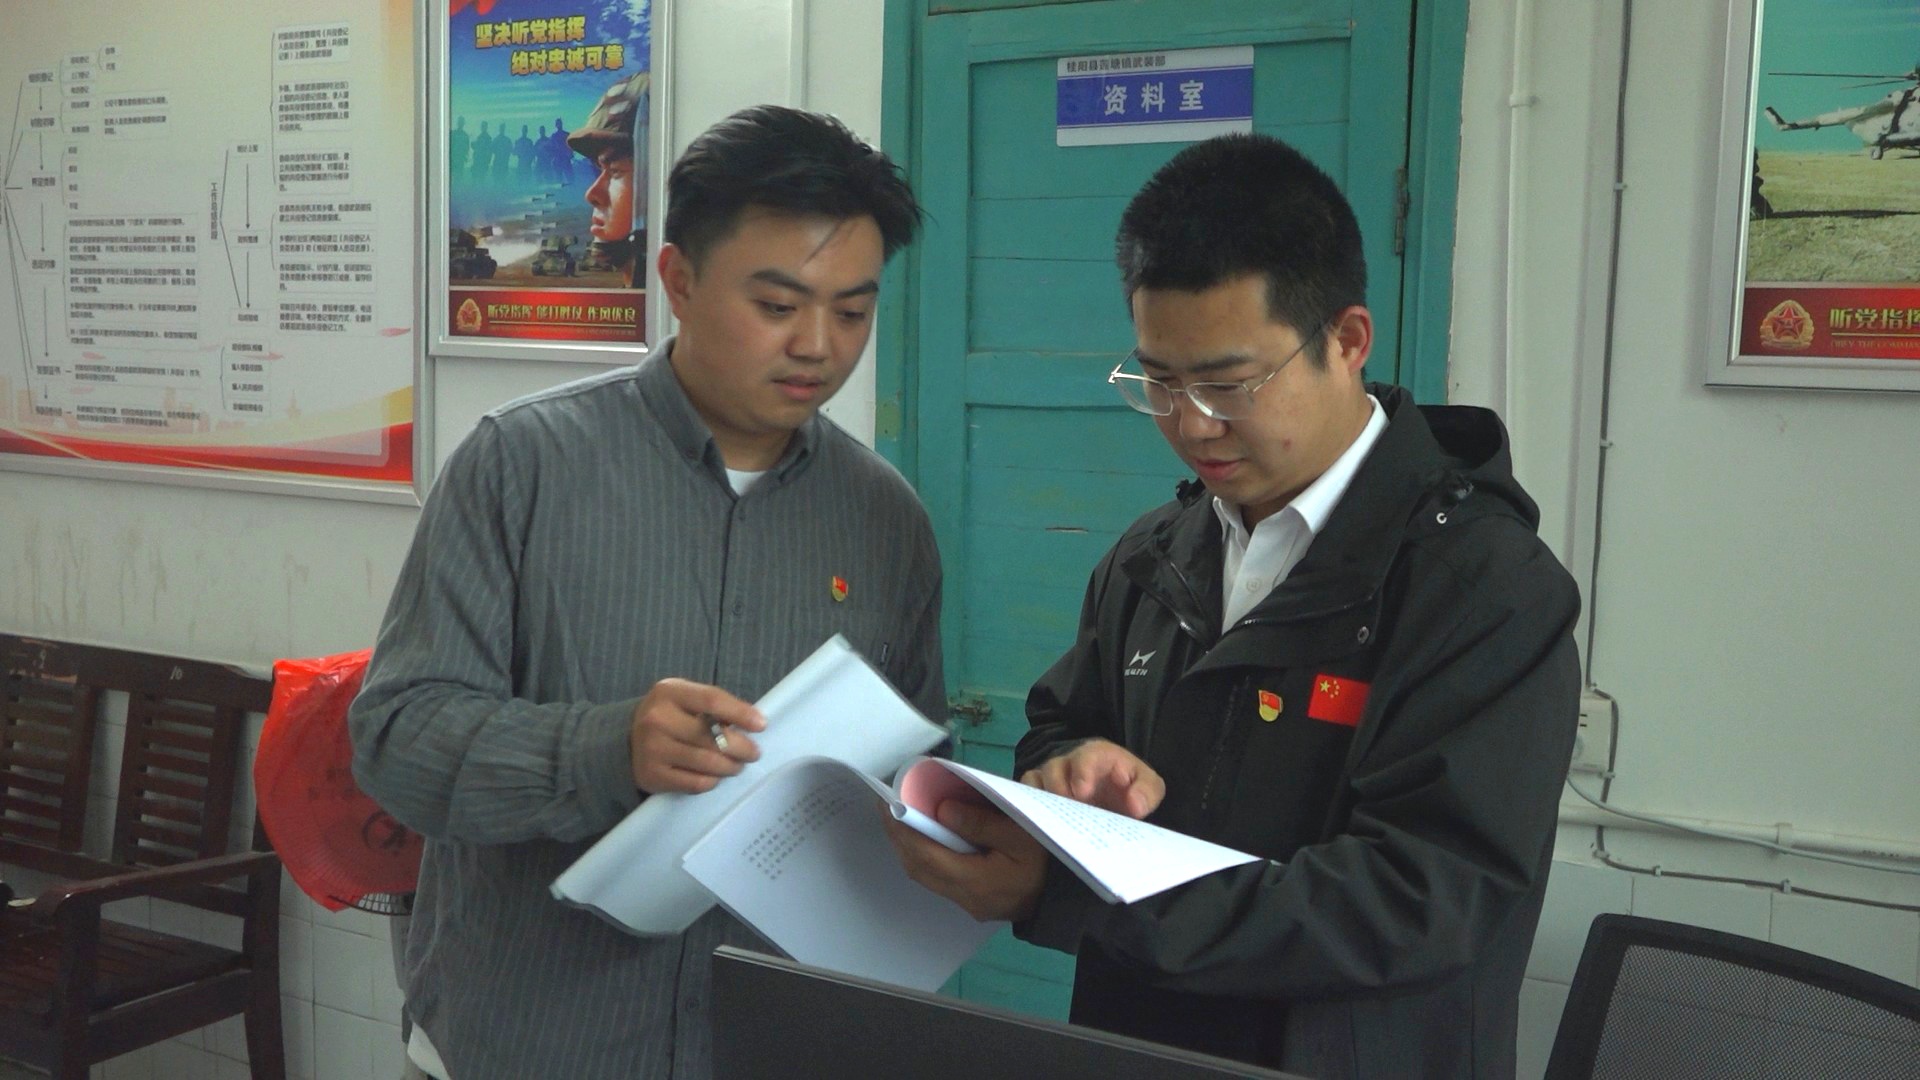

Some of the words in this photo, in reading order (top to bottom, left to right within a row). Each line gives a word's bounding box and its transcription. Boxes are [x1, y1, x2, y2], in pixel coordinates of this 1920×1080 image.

[476, 17, 585, 48] 坚决听党指挥
[512, 46, 623, 75] 绝对忠诚可靠
[1104, 80, 1204, 115] 资料室
[487, 304, 533, 319] 听党指挥
[536, 305, 582, 321] 能打胜仗
[588, 306, 636, 323] 作风优良
